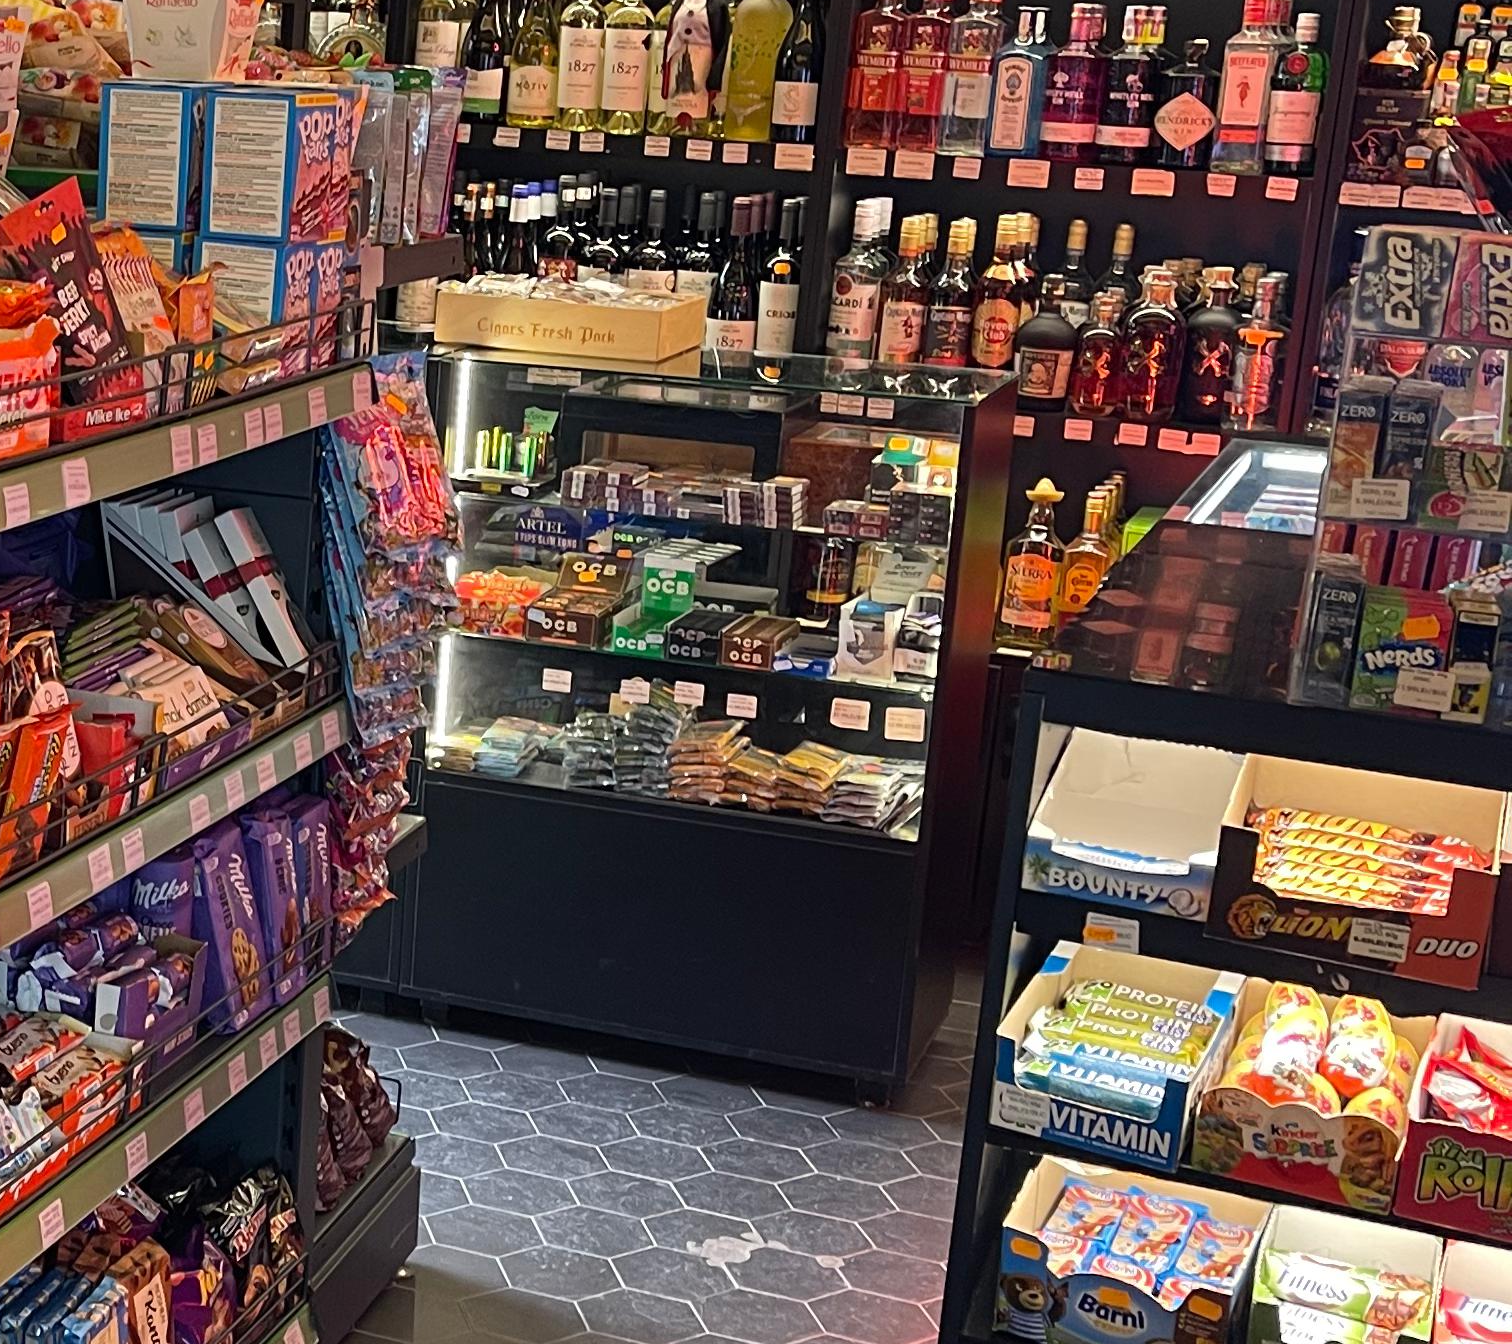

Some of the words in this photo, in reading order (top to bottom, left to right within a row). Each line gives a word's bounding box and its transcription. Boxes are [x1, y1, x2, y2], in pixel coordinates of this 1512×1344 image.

[1384, 235, 1421, 331] Extra
[715, 334, 744, 349] 1827
[646, 576, 690, 596] OCB
[541, 617, 578, 635] OCB
[615, 636, 648, 653] OCB
[132, 876, 190, 908] Milka
[229, 852, 255, 921] Milka
[1045, 868, 1158, 905] BOUNTY
[1414, 937, 1481, 959] DUO
[1045, 1104, 1173, 1159] VITAMIN
